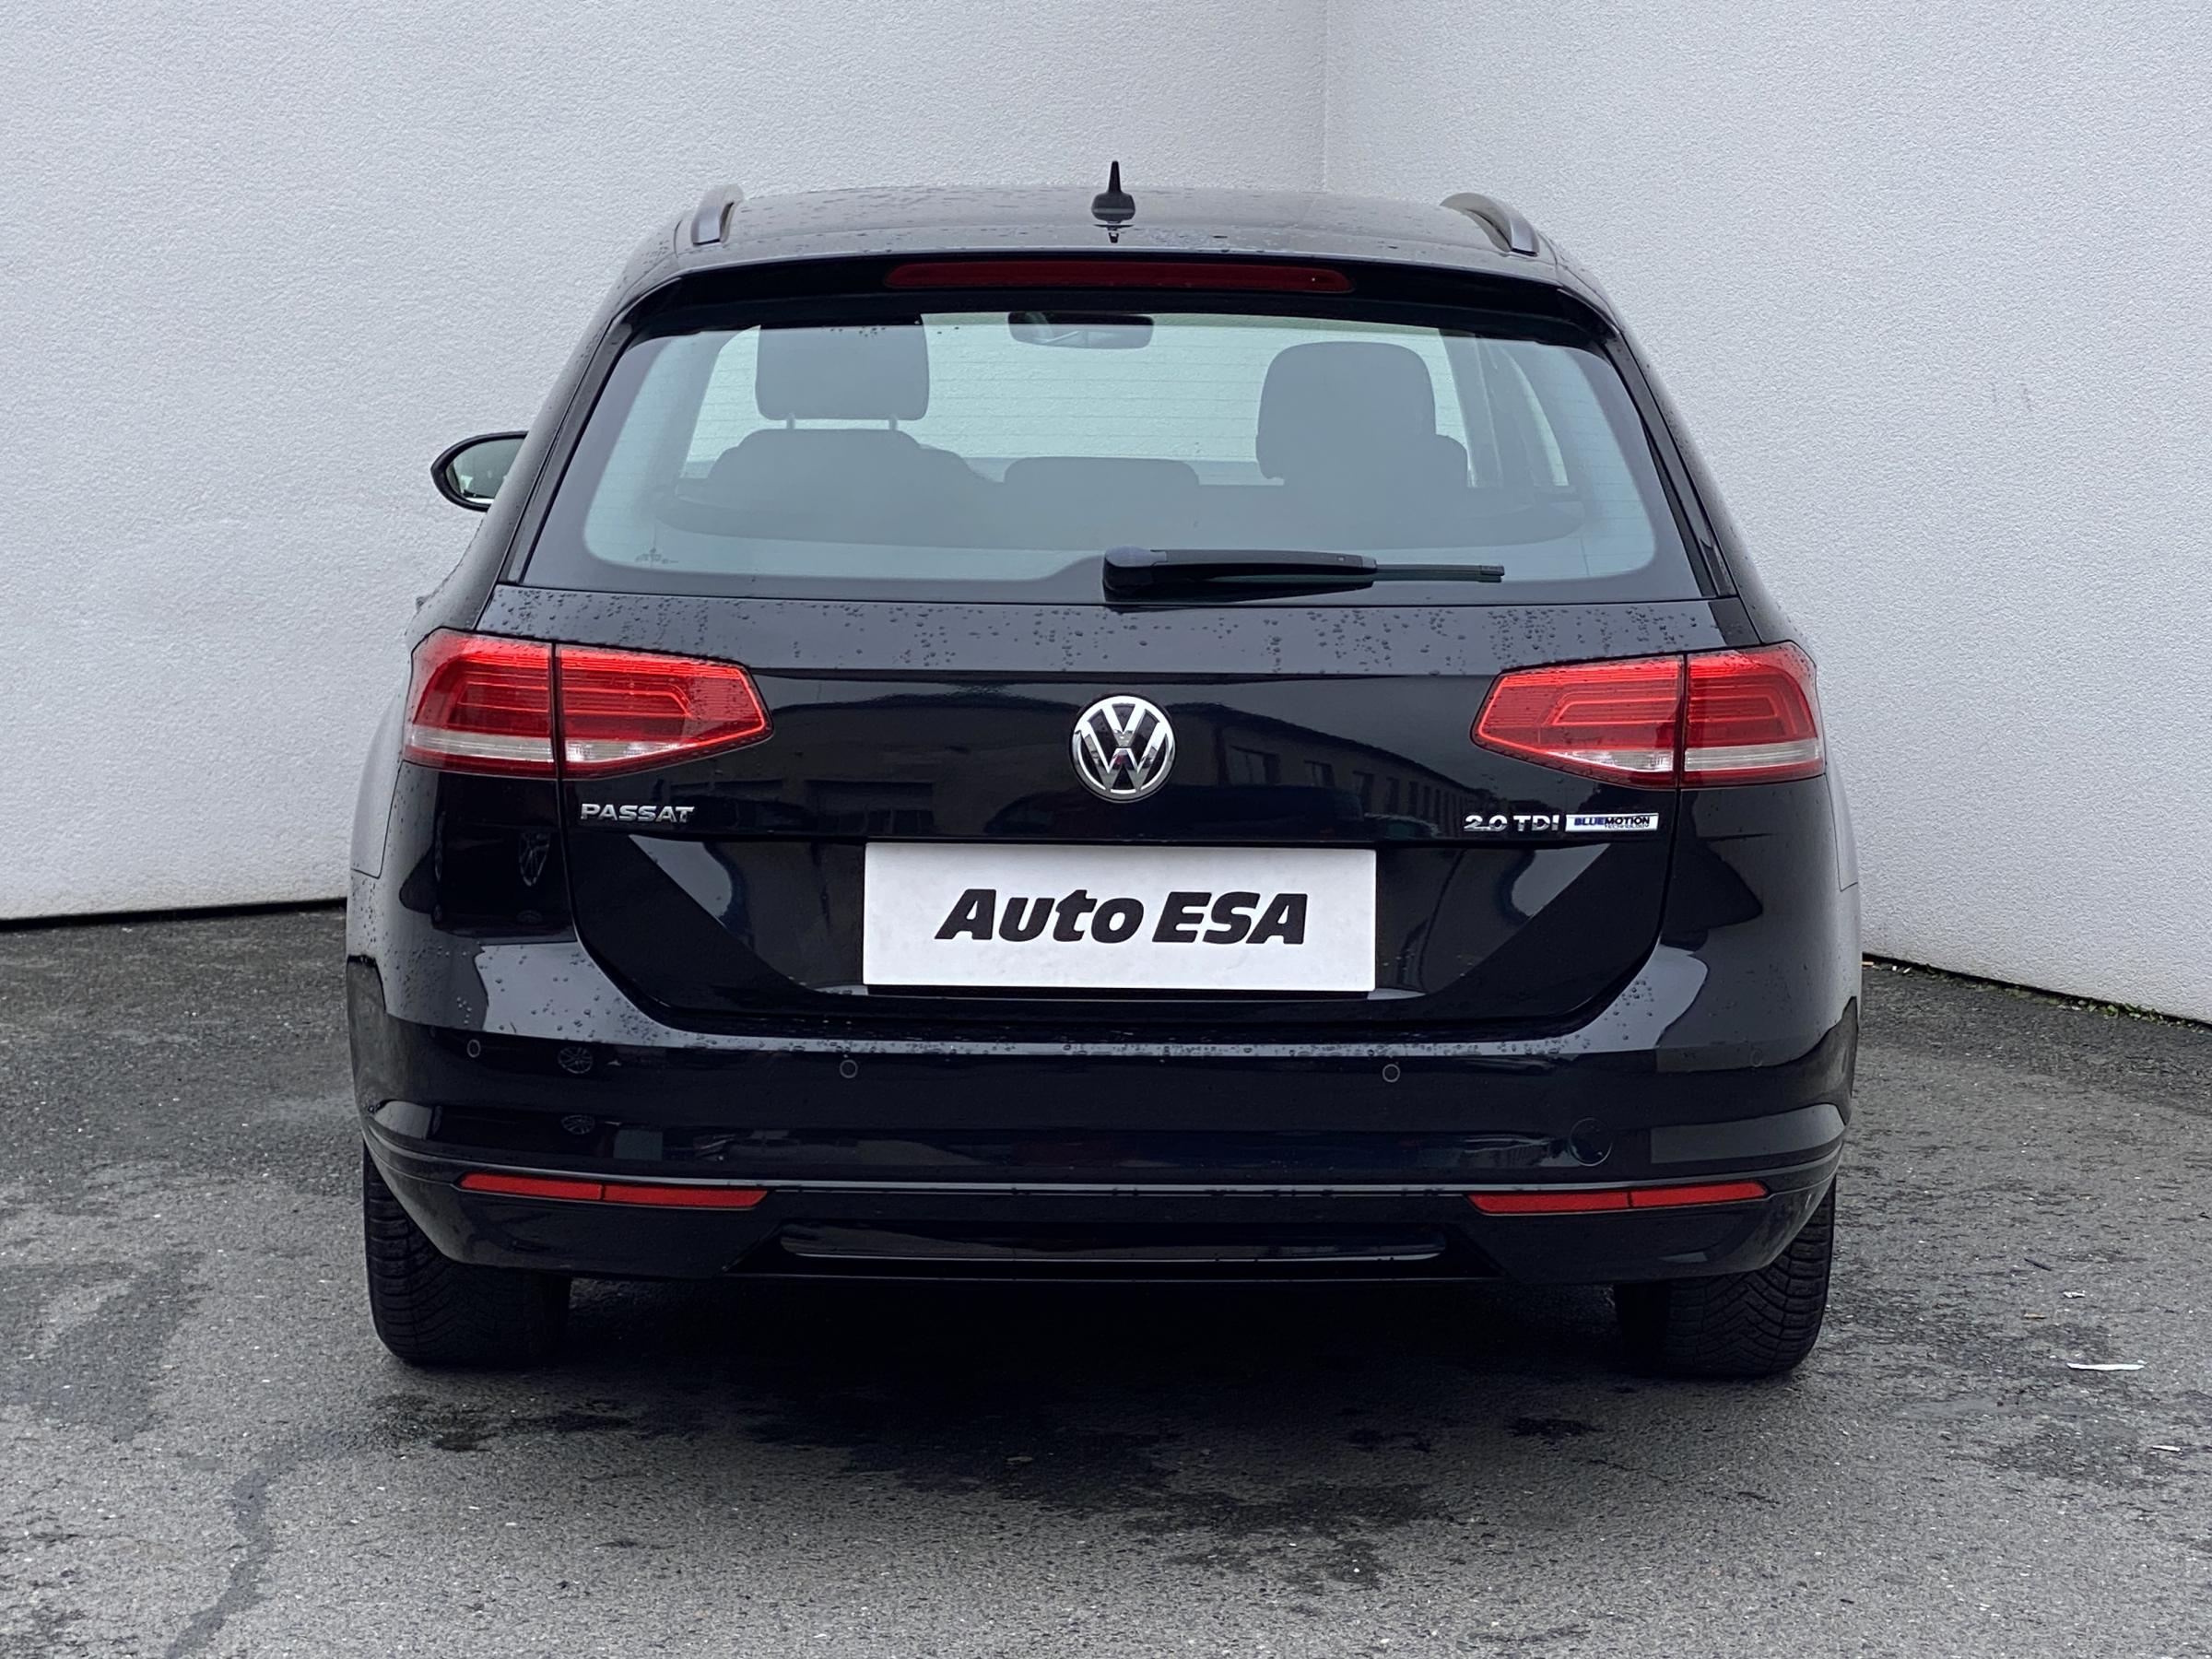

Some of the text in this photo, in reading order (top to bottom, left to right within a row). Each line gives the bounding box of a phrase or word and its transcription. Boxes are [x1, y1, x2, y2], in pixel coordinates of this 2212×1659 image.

[1072, 695, 1176, 800] VW
[580, 803, 695, 823] PASSAT
[1513, 815, 1559, 831] TDI
[1574, 817, 1650, 826] BLUEMOTION
[935, 888, 1308, 945] Auto ESA
